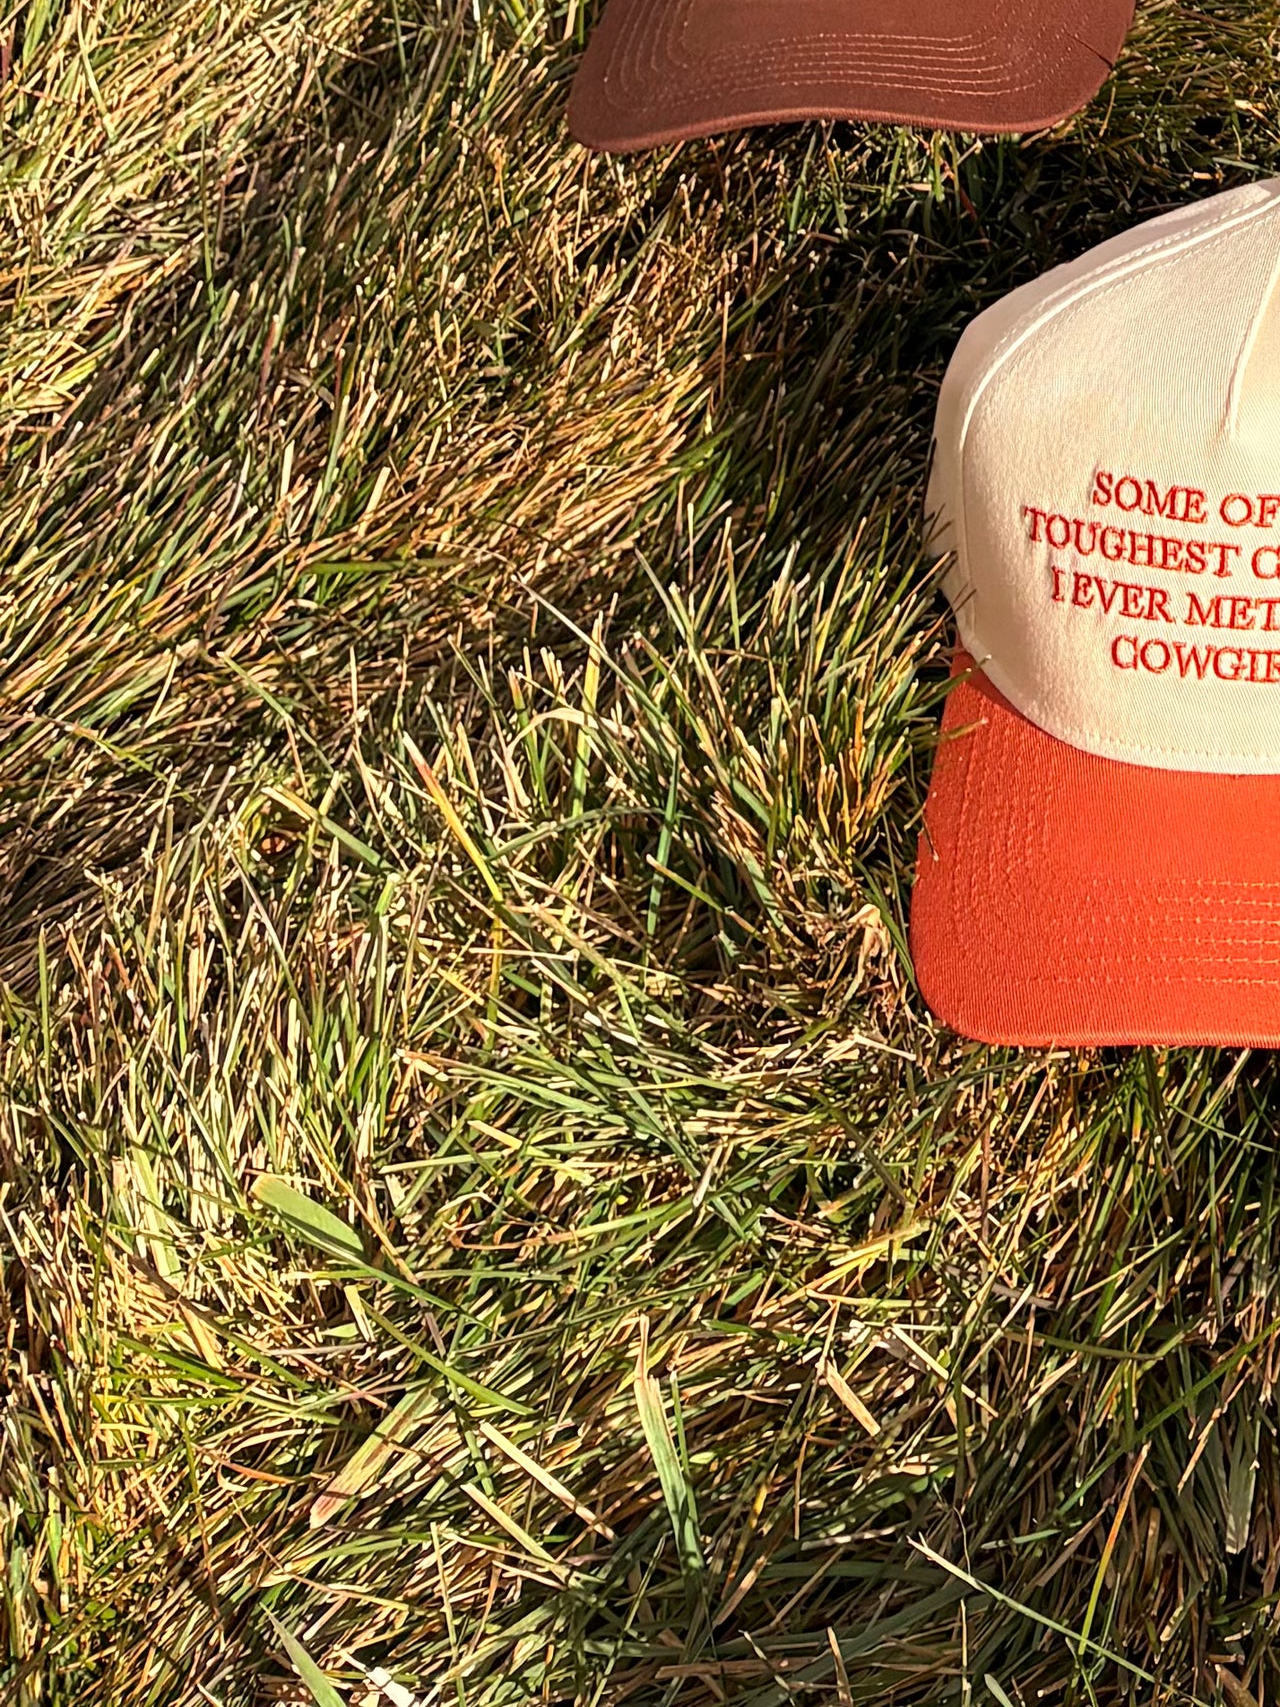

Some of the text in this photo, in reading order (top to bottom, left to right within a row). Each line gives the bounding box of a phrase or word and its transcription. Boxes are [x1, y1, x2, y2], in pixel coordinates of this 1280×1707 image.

[1091, 470, 1208, 524] SOME
[1023, 505, 1241, 578] TOUGHEST
[1049, 565, 1067, 603] I
[1071, 575, 1176, 624] EVER
